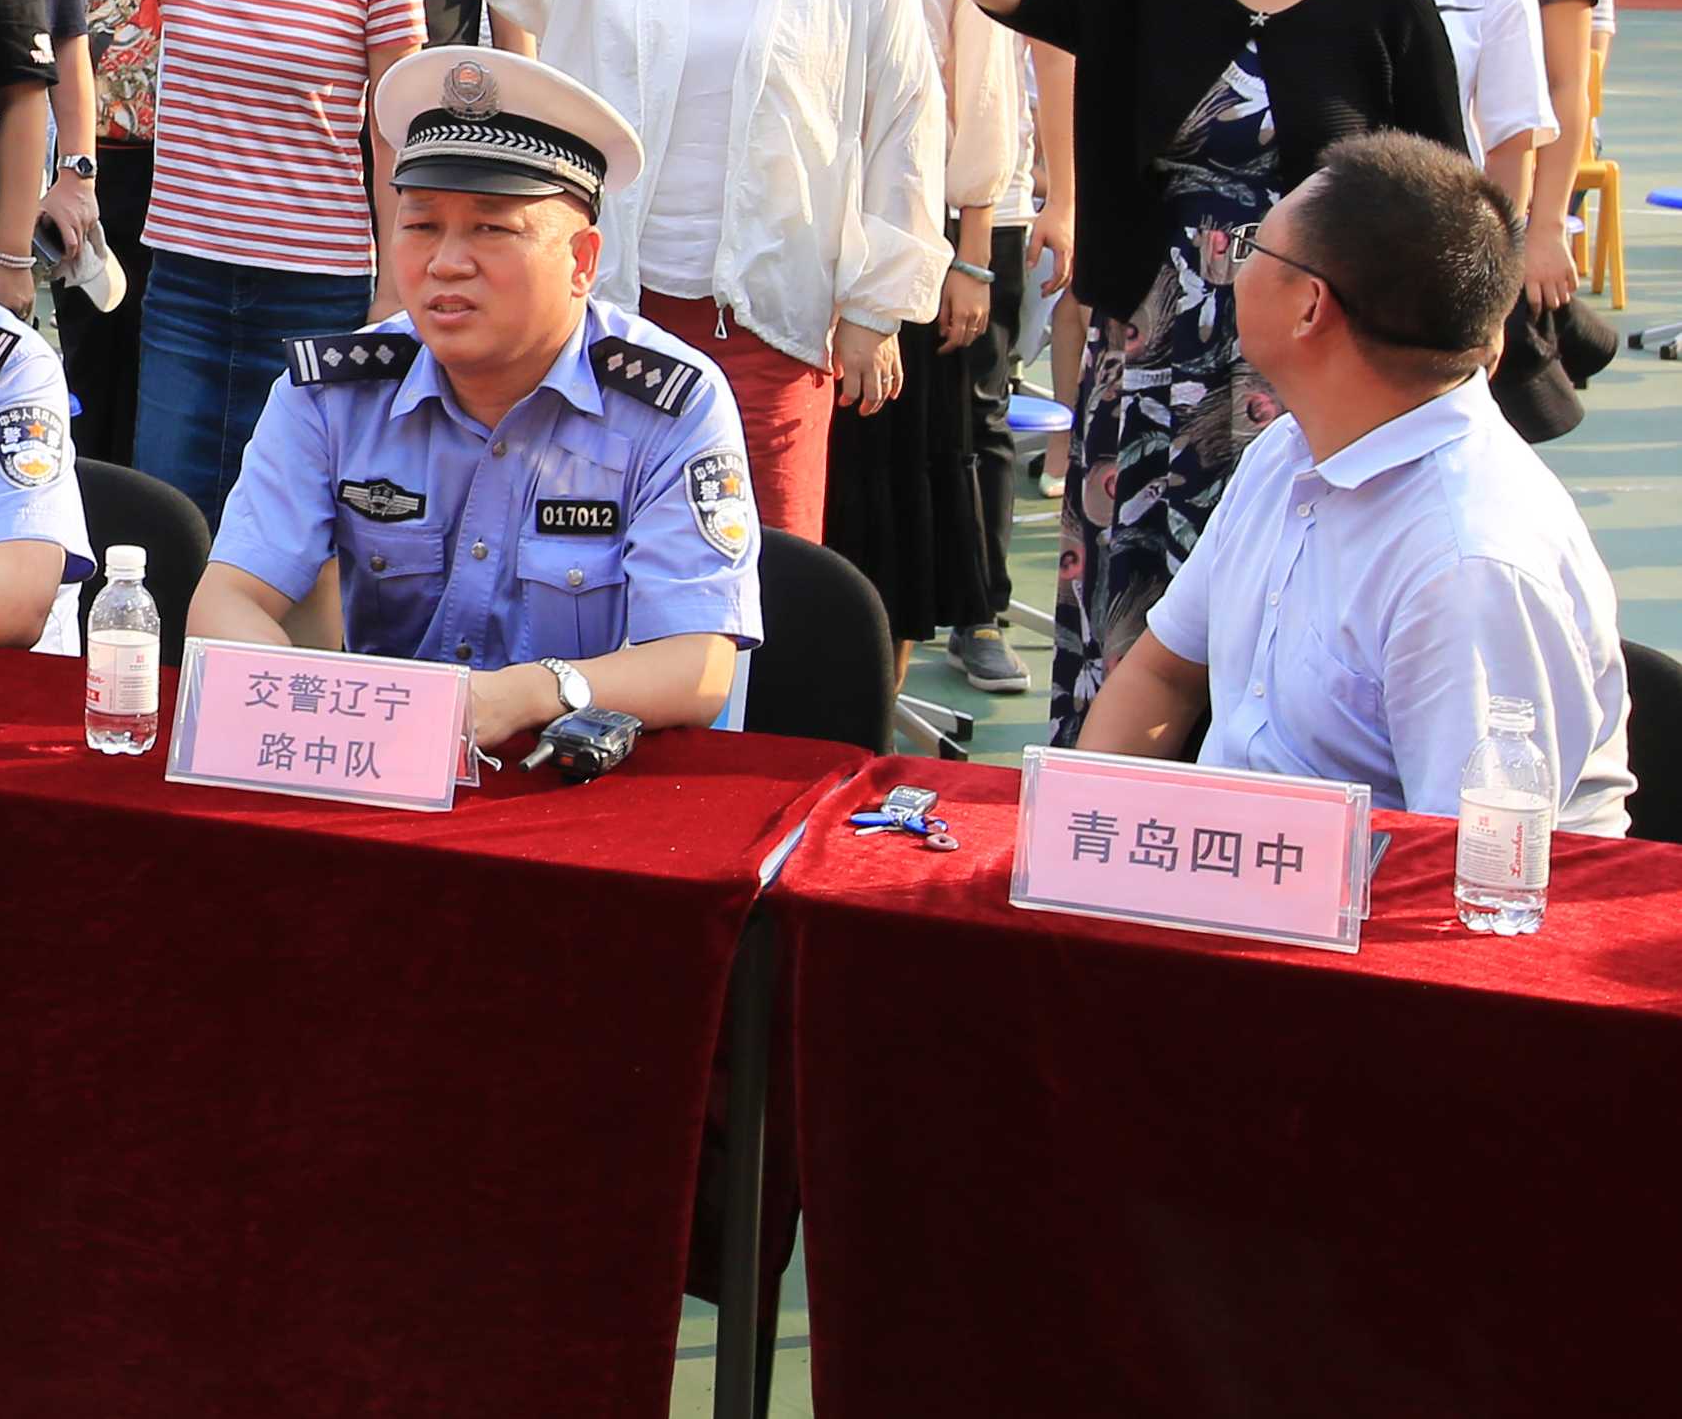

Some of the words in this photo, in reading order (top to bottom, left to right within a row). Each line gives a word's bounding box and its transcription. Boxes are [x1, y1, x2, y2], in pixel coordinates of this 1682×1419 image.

[542, 504, 614, 530] 017012
[244, 669, 412, 722] 交警辽宁
[258, 732, 383, 780] 路中队
[1066, 810, 1307, 886] 青岛四中
